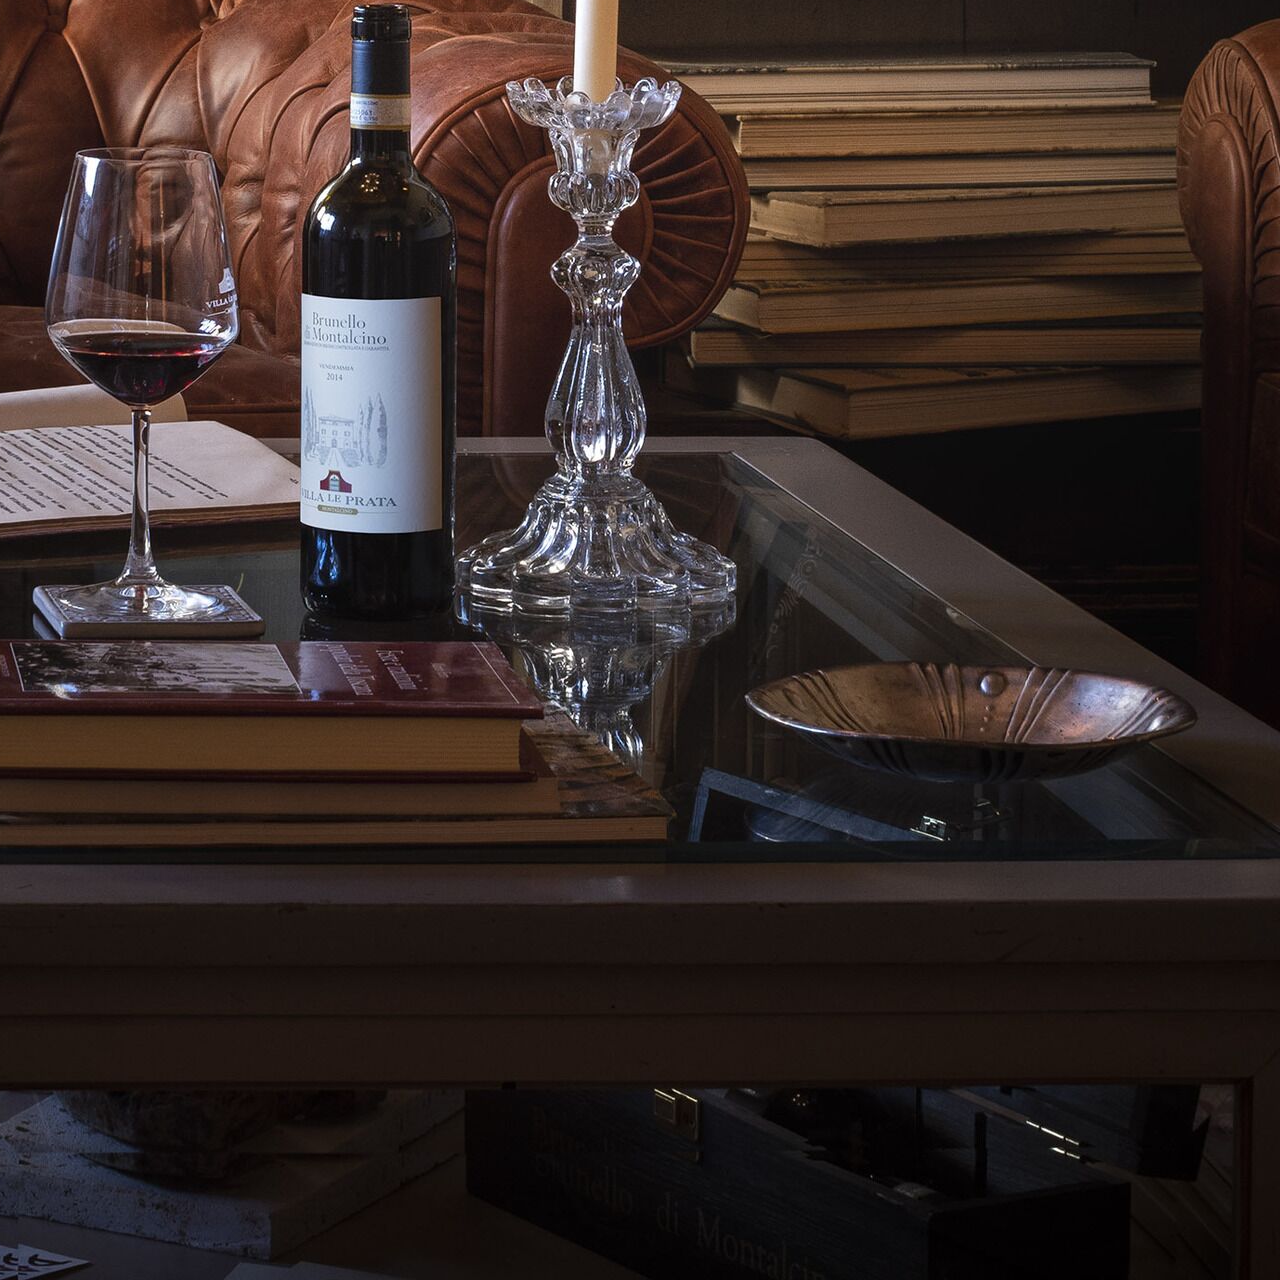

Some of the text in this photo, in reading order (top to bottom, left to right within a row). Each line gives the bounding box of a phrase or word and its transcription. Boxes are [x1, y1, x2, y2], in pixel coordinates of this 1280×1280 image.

[312, 311, 366, 329] Brunello
[312, 327, 387, 345] Montalcino
[326, 372, 343, 381] 2014
[301, 488, 397, 507] VILLA LE PRATA
